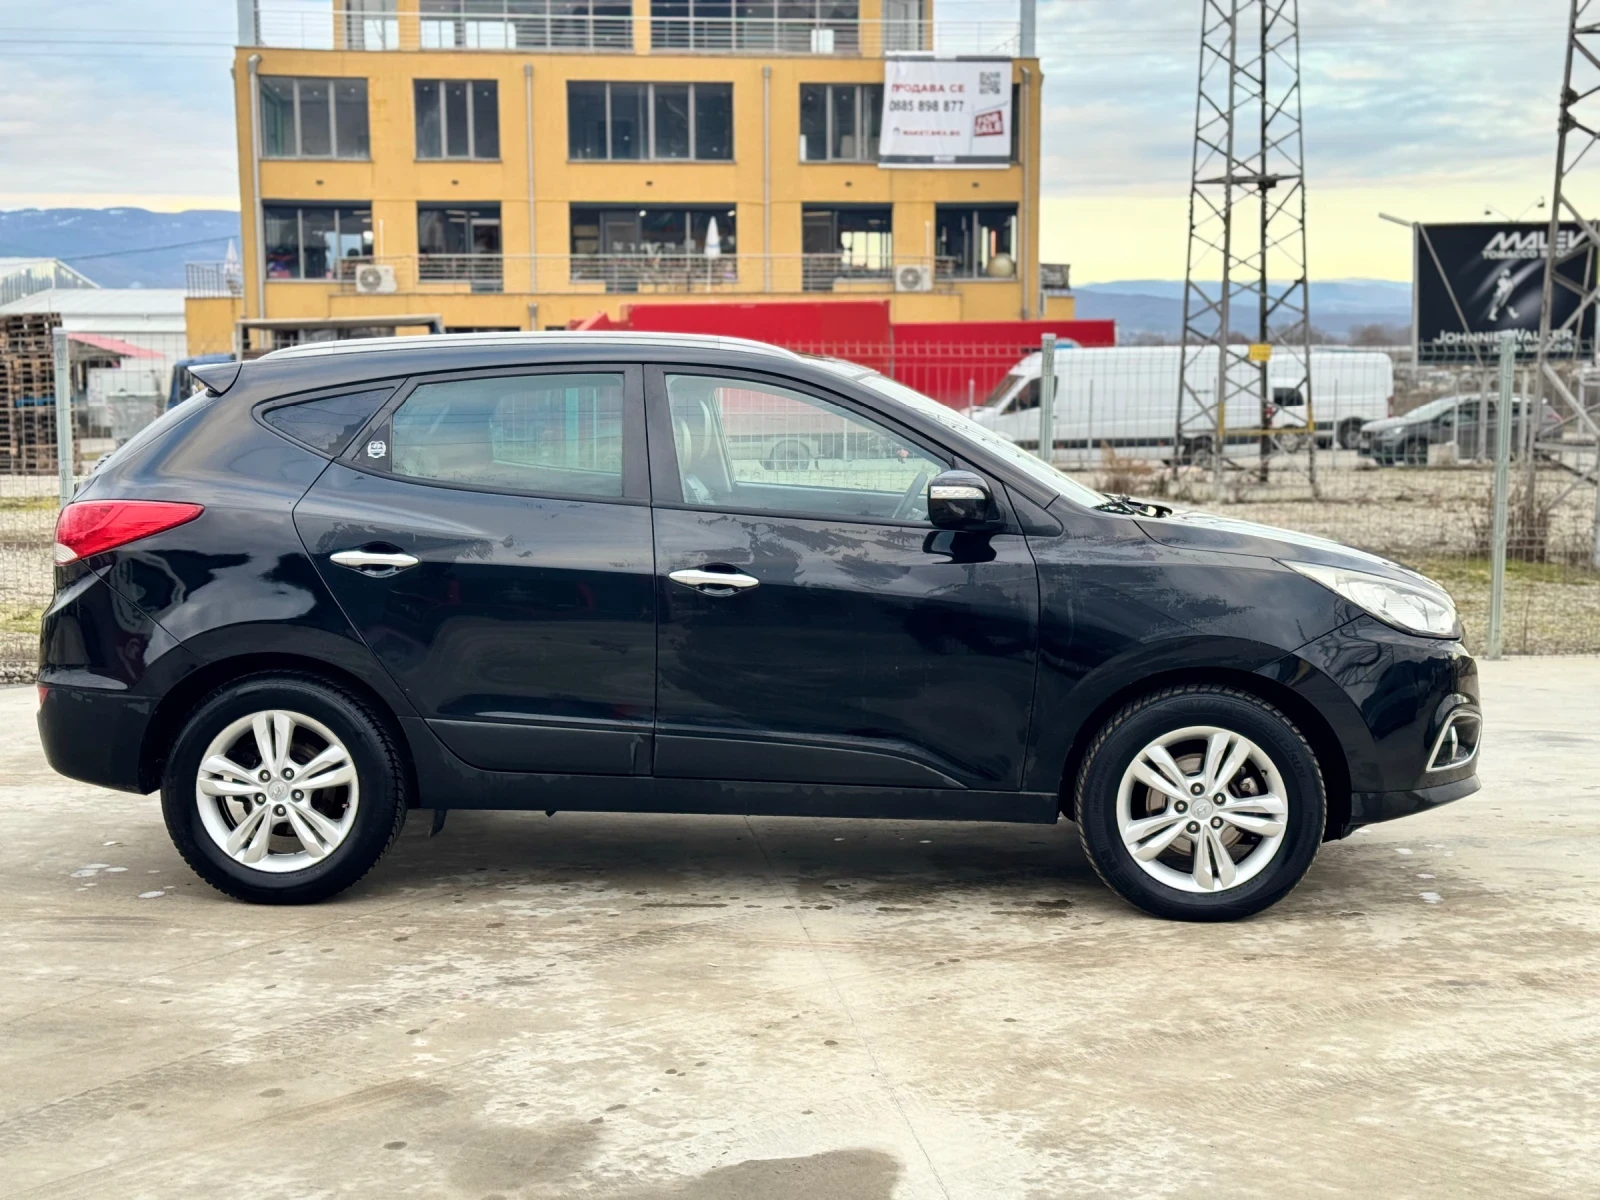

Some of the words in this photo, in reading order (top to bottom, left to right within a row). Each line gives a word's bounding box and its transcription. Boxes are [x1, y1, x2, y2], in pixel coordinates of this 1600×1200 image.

[891, 83, 945, 93] ПРОДАВА
[949, 83, 965, 93] СЕ
[918, 100, 939, 112] 898
[943, 100, 964, 112] 877
[1482, 230, 1588, 250] MALEV
[1482, 249, 1539, 260] TOBACCO
